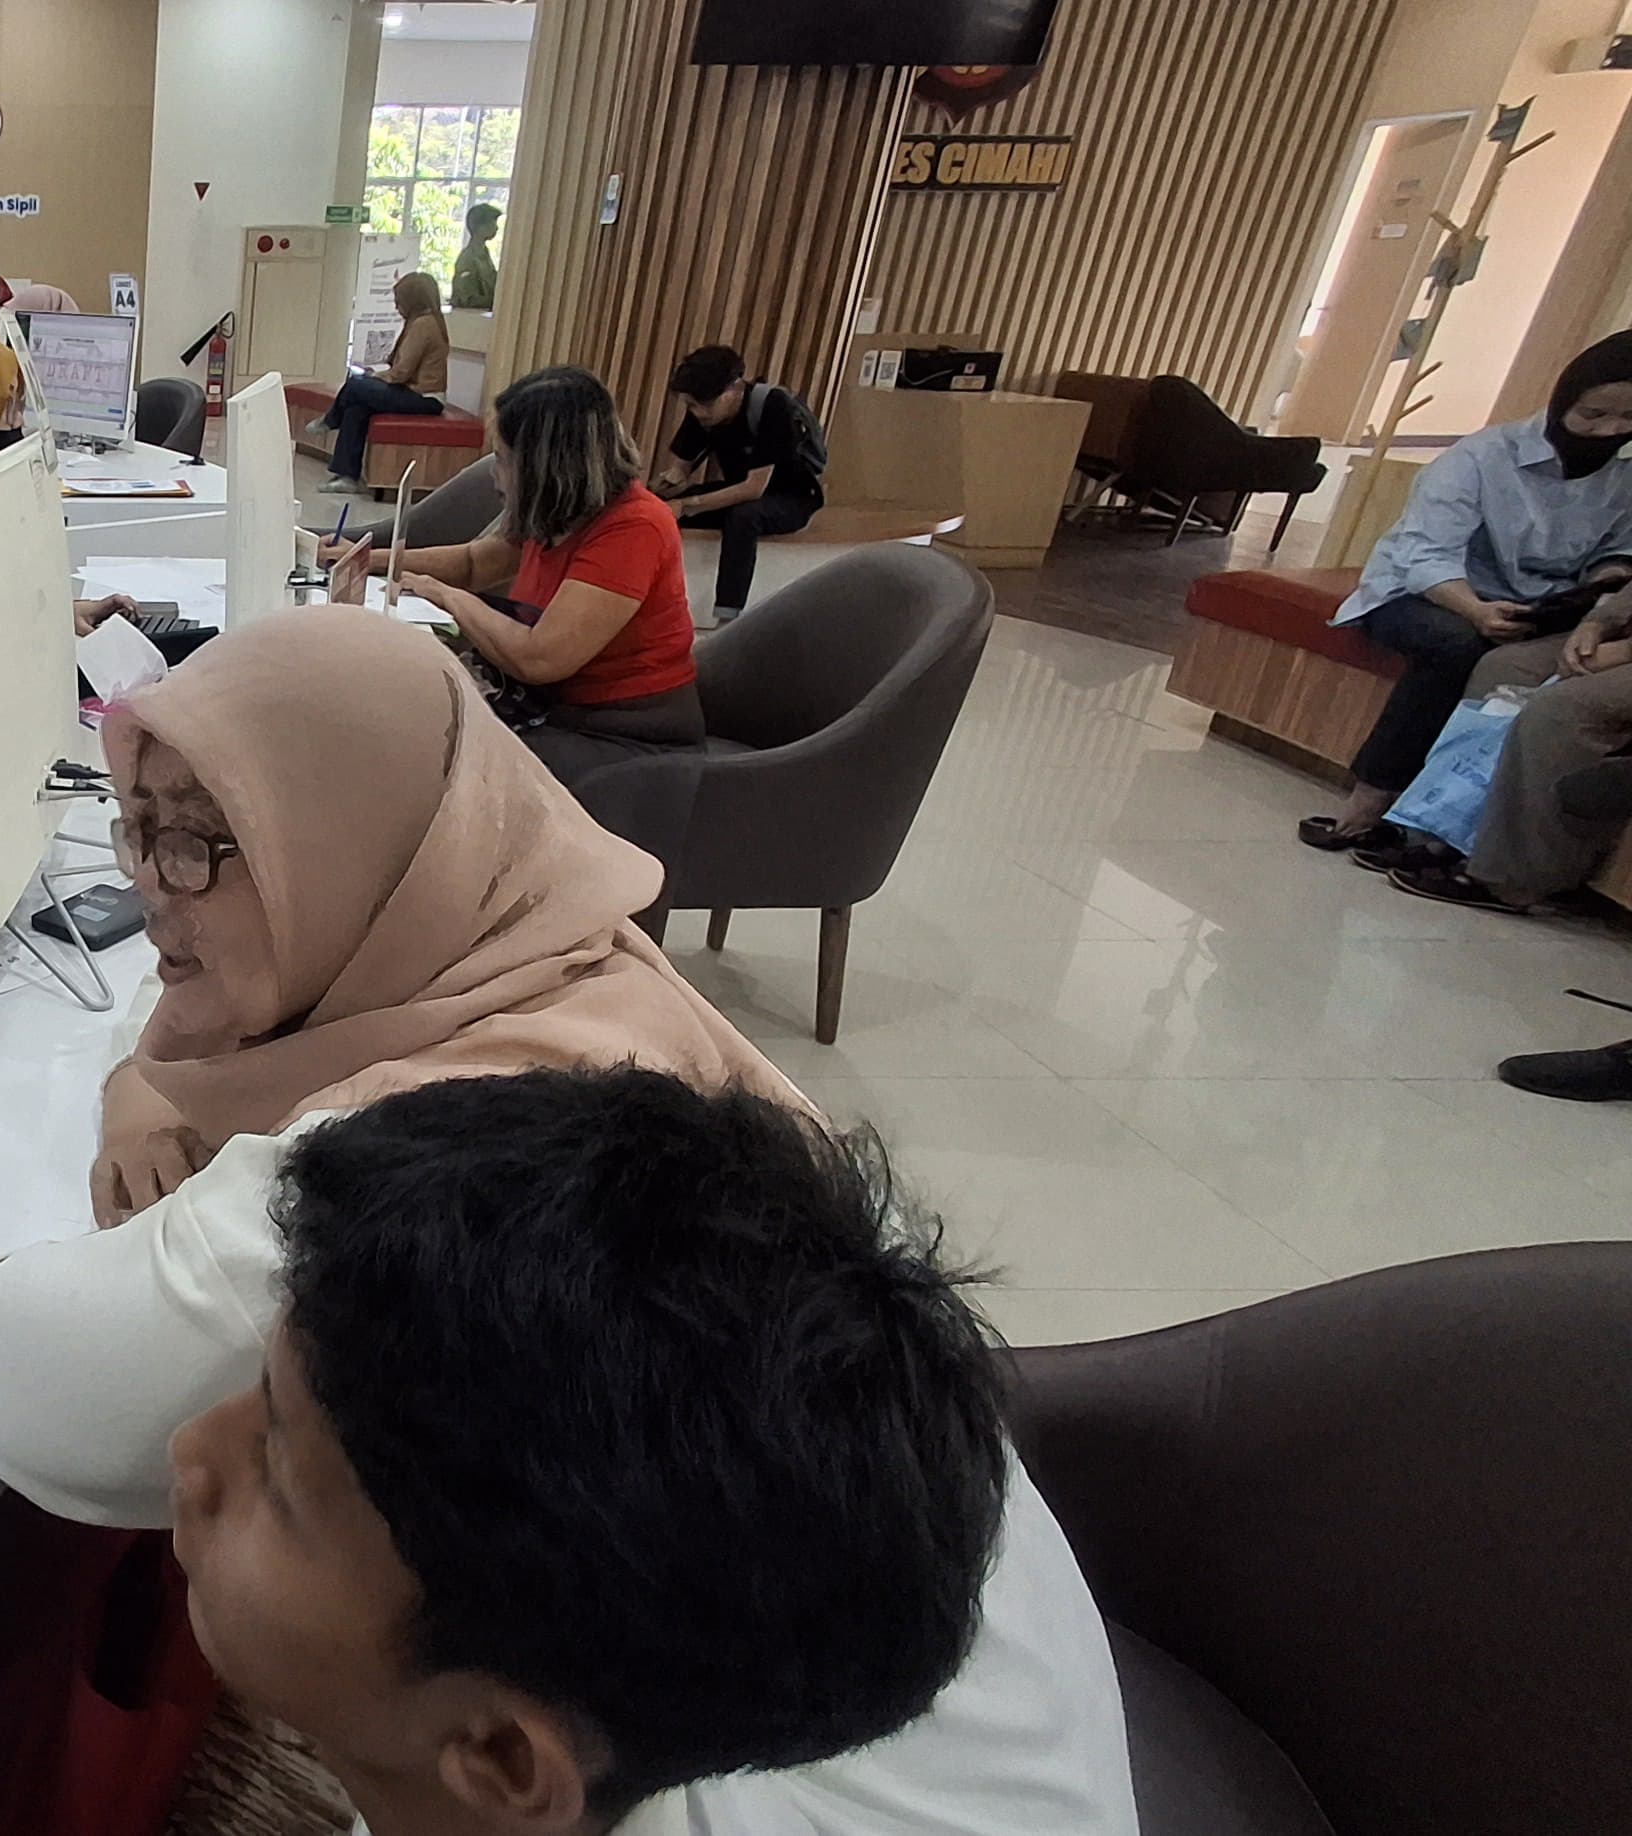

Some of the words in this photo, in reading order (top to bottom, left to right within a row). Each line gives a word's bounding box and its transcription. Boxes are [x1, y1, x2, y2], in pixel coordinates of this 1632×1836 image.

[937, 142, 1071, 185] CIMAHI
[7, 196, 37, 213] Sipil
[115, 290, 135, 308] A4
